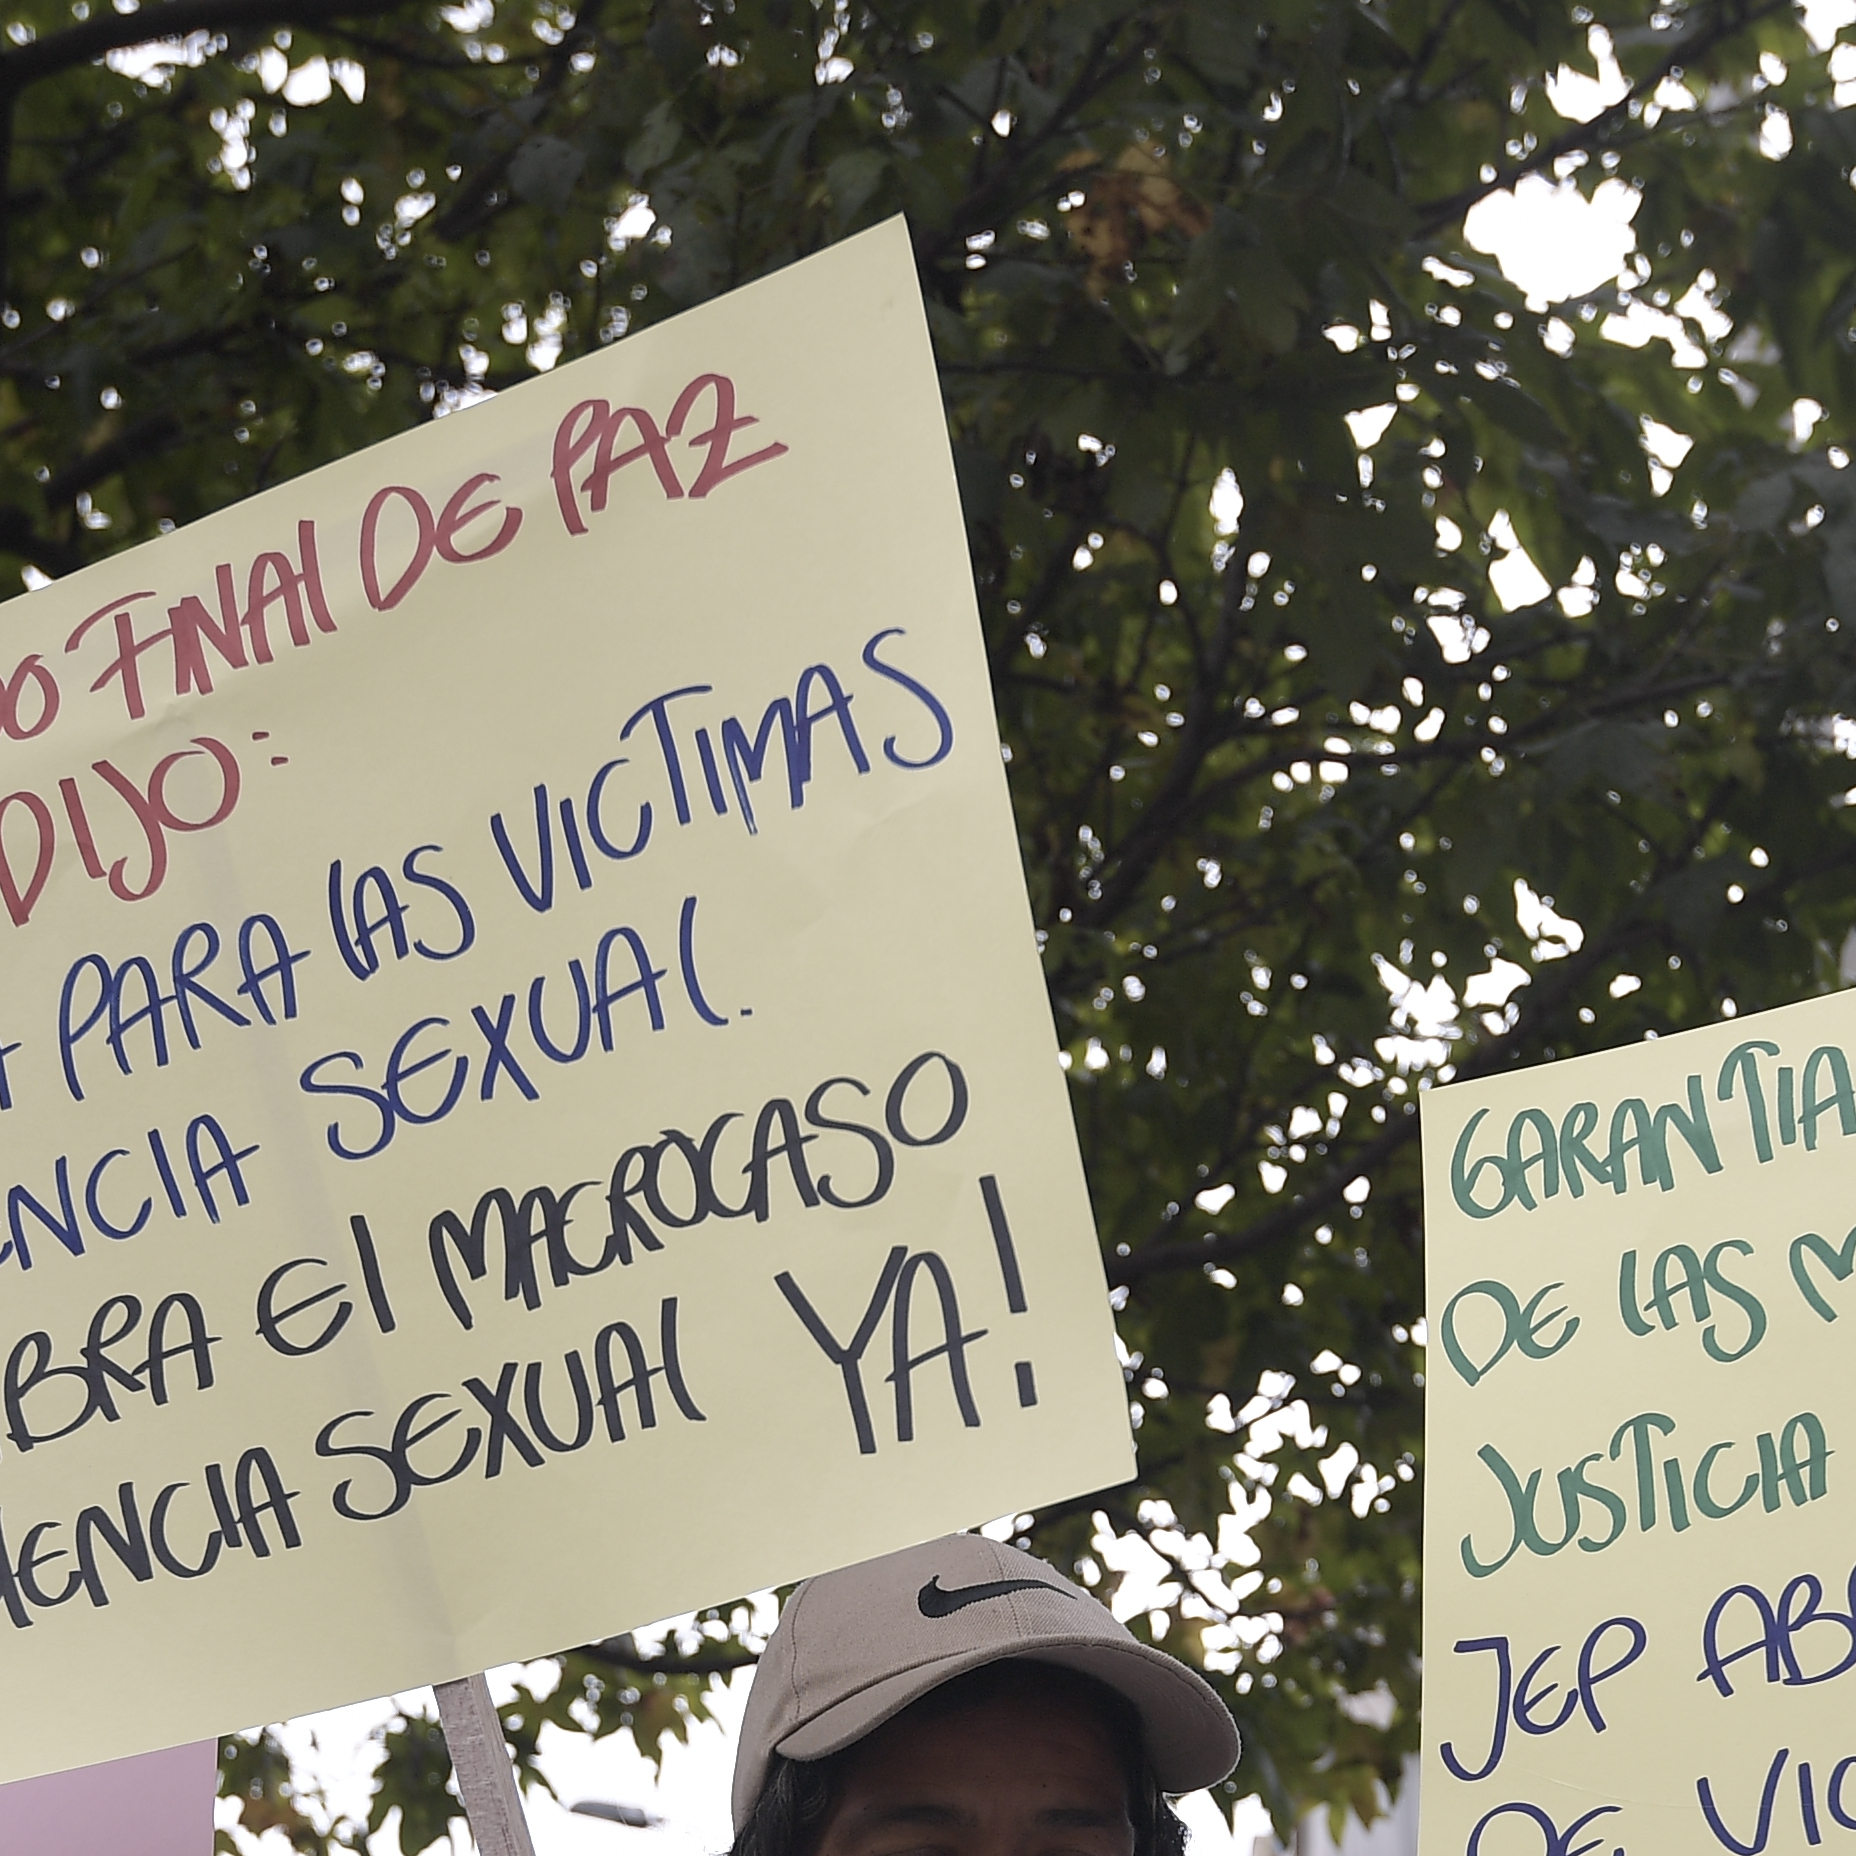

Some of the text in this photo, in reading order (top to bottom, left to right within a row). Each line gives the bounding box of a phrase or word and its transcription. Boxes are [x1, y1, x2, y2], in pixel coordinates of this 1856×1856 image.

[360, 472, 525, 612] DE
[551, 373, 789, 535] PAZ
[53, 911, 311, 1101] PARA
[491, 628, 955, 912] VICTIMAS
[428, 1053, 971, 1329] MACROCASO
[777, 1174, 1043, 1456] YA!
[1440, 1281, 1580, 1387] DE
[1461, 1411, 1833, 1578] JUSTICIA
[1440, 1615, 1648, 1782] JEP
